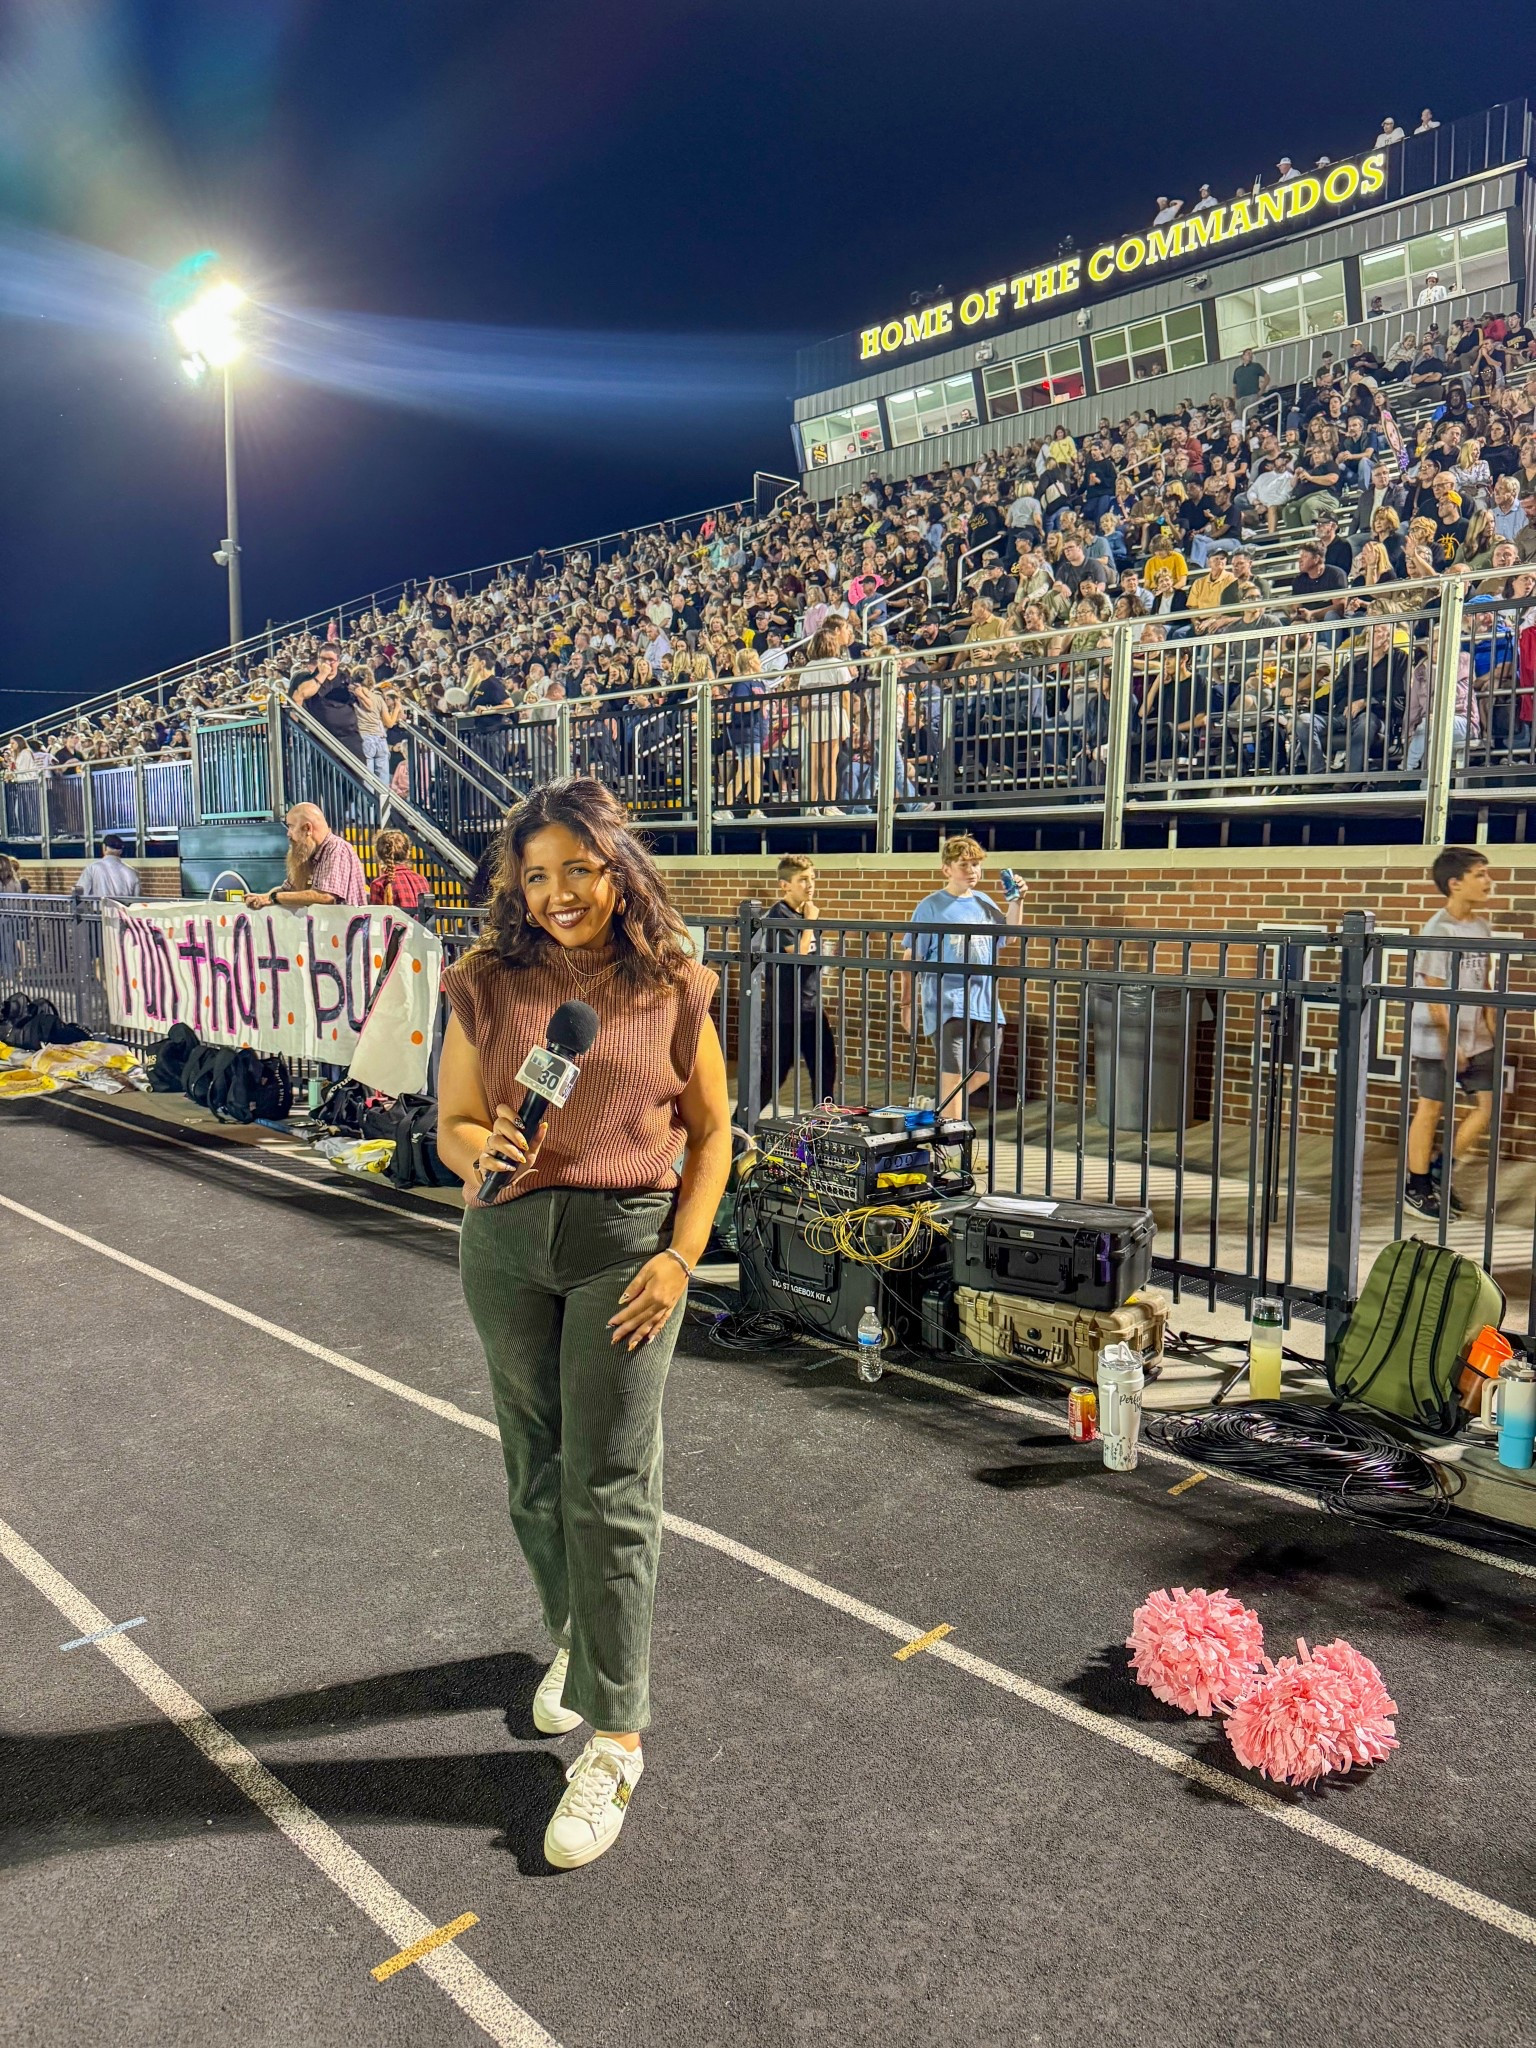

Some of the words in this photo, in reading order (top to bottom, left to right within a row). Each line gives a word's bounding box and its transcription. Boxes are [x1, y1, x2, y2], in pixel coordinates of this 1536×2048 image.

[860, 303, 951, 360] HOME
[958, 285, 1006, 326] OF
[1011, 257, 1080, 310] THE
[1086, 155, 1387, 283] COMMANDOS
[177, 913, 291, 1035] that
[537, 1070, 560, 1091] 30
[815, 1292, 826, 1302] KIT
[826, 1295, 832, 1304] A
